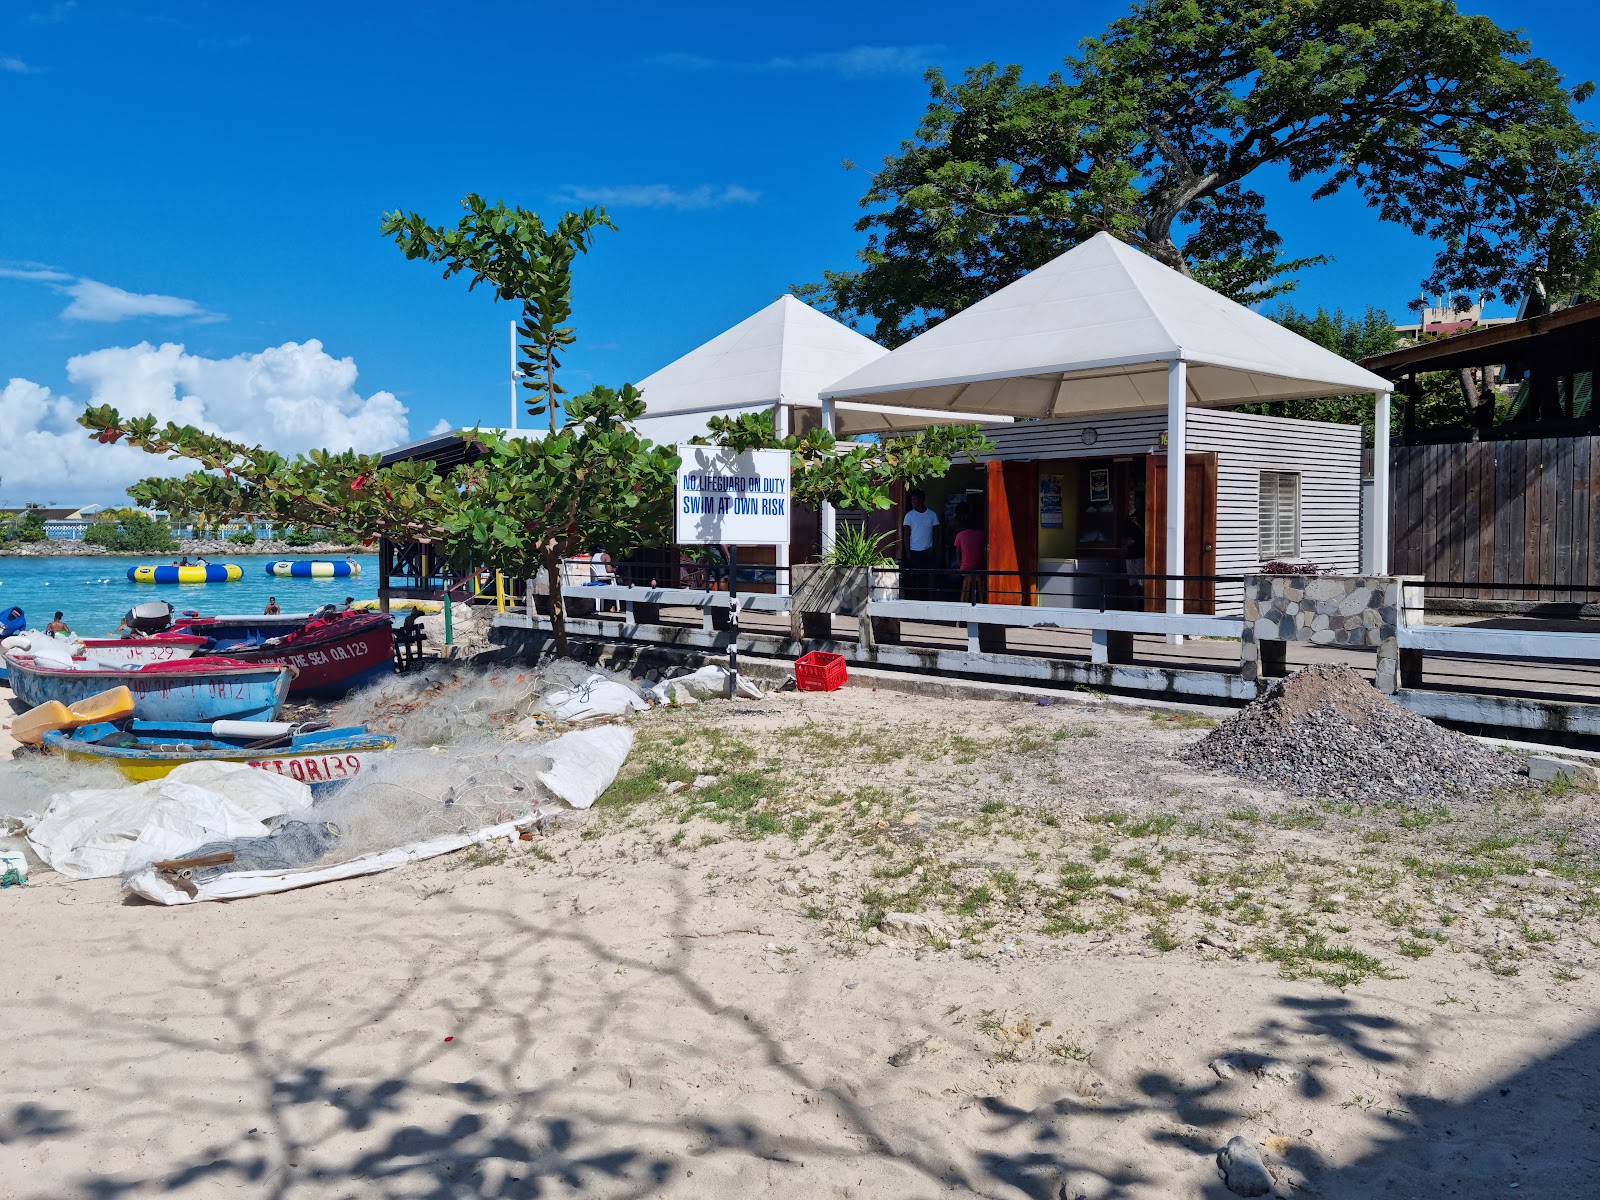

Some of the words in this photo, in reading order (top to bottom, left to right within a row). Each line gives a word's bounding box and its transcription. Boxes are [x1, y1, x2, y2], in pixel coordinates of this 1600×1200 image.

[683, 474, 696, 490] NO
[700, 475, 746, 492] LIFEGUARD
[748, 477, 761, 492] ON
[764, 478, 785, 493] DUTY
[683, 495, 714, 514] SWIM
[718, 496, 731, 515] AT
[734, 497, 758, 515] OWN
[762, 498, 785, 516] RISK
[150, 646, 174, 660] 329
[288, 653, 309, 668] THE
[307, 650, 330, 666] SEA
